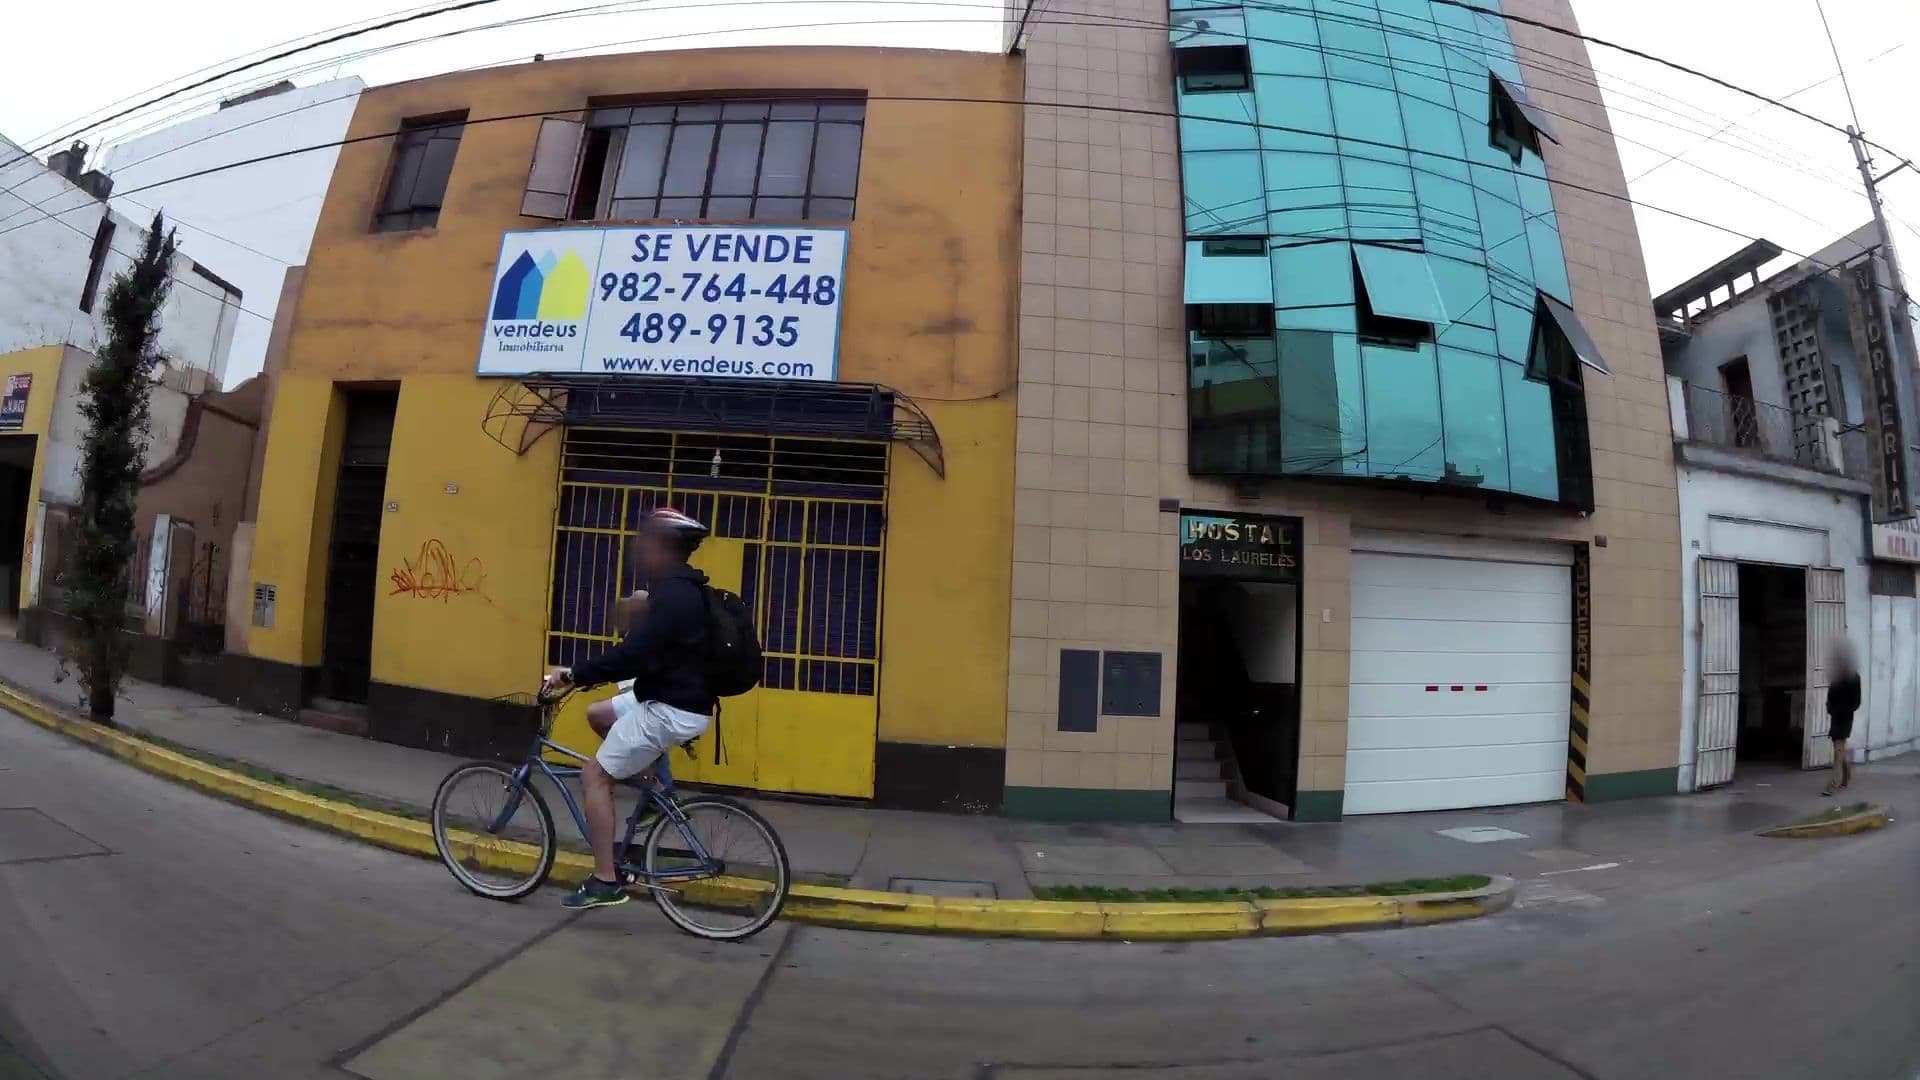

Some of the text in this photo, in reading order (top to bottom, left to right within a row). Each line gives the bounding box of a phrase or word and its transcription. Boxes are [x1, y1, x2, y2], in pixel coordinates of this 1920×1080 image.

[631, 233, 814, 264] SE VENDE
[600, 272, 836, 306] 982-764-448
[493, 320, 577, 338] vendeus
[620, 312, 800, 347] 489-9135
[602, 355, 814, 377] www.vendeus.com
[1188, 519, 1293, 545] HOSTAL
[1183, 547, 1297, 567] LOS LAURELES
